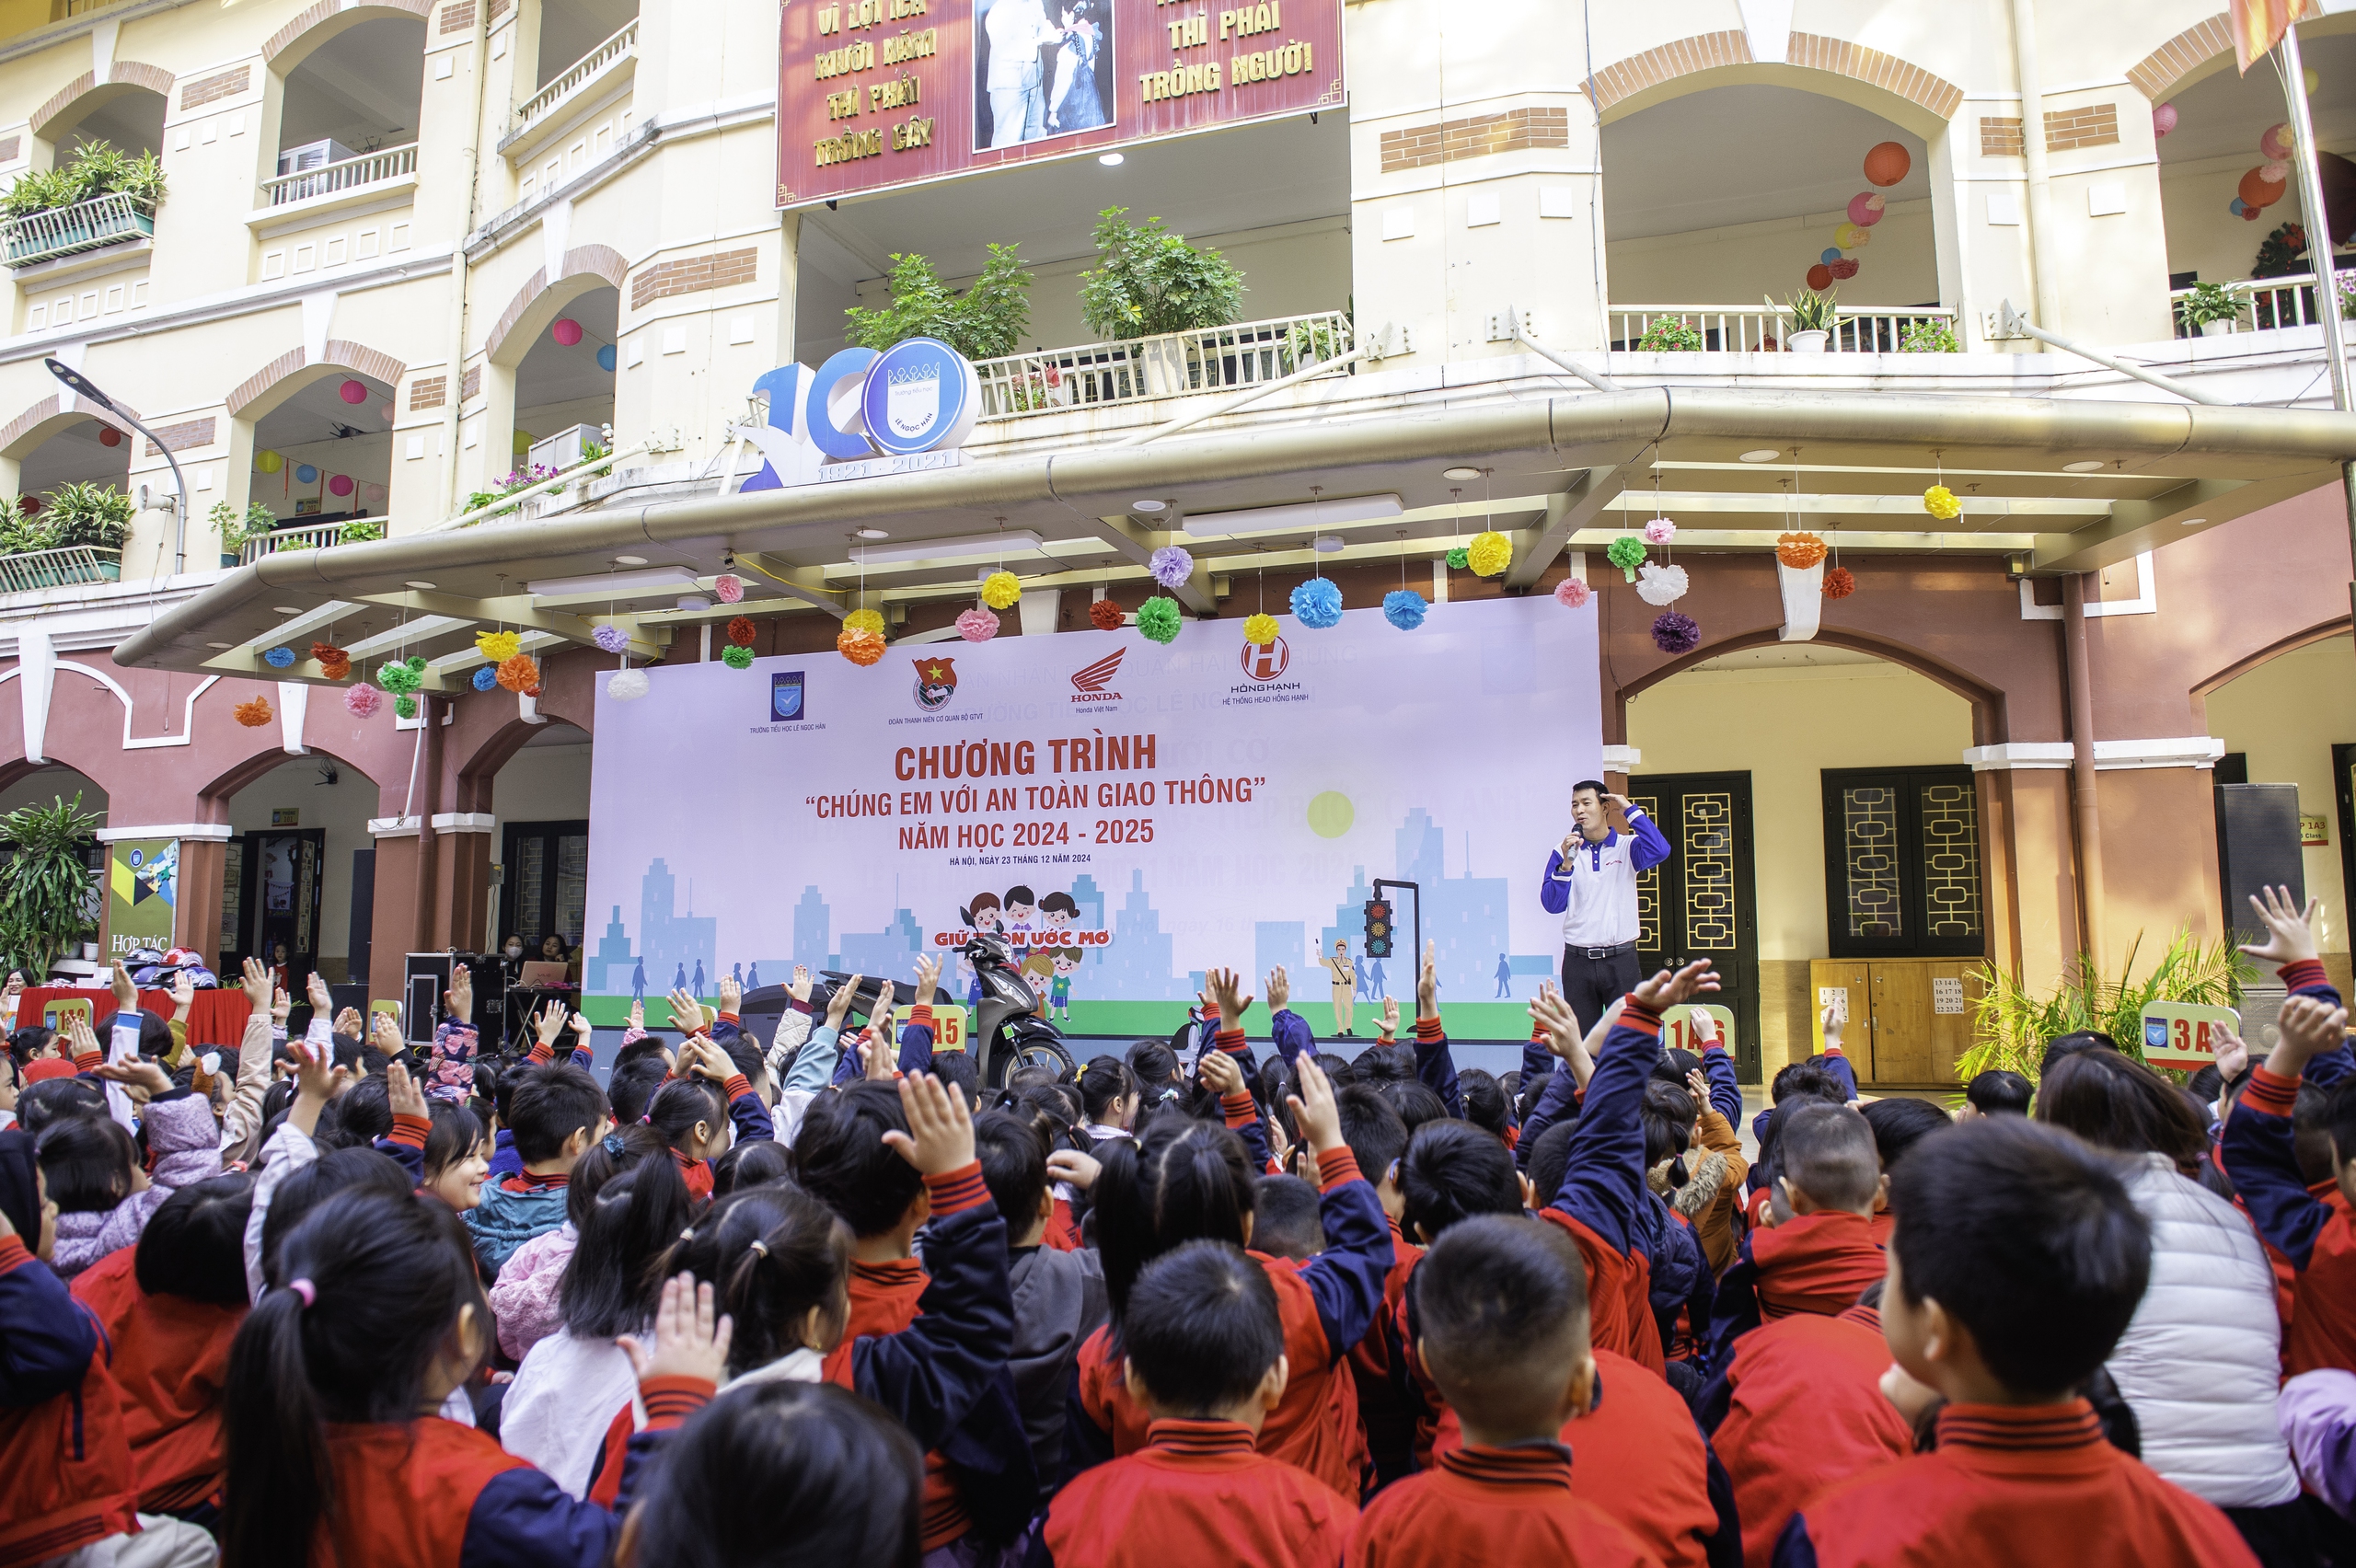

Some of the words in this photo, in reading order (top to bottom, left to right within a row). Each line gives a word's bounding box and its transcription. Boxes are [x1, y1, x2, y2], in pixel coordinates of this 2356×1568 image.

[818, 2, 839, 35] VÌ
[1168, 10, 1207, 50] THÌ
[1219, 0, 1280, 40] PHẢI
[814, 38, 874, 81] MƯỜI
[883, 28, 937, 66] NĂM
[1139, 58, 1222, 103] TRỒNG
[1231, 39, 1312, 87] NGƯỜI
[826, 84, 860, 121] THÌ
[868, 71, 920, 112] PHẢI
[814, 124, 884, 167] TRỒNG
[891, 114, 935, 153] CÂY
[818, 461, 872, 482] 1921
[892, 451, 953, 473] 2021
[1070, 692, 1123, 703] HONDA
[1222, 697, 1230, 706] HỆ
[1232, 696, 1253, 705] THỐNG
[1254, 696, 1271, 704] HEAD
[1272, 694, 1290, 702] HỒNG
[1290, 694, 1309, 702] HẠNH
[750, 725, 770, 733] TRƯỜNG
[770, 724, 781, 732] TIỂU
[781, 724, 792, 732] HỌC
[801, 723, 814, 732] NGỌC
[814, 722, 826, 731] HÂN
[888, 717, 904, 725] ĐOÀN
[905, 716, 922, 724] THANH
[922, 715, 935, 723] NIÊN
[944, 714, 960, 722] QUAN
[961, 713, 969, 721] BỘ
[969, 712, 984, 721] GTVT
[895, 738, 1035, 781] CHƯƠNG
[1047, 728, 1156, 774] TRÌNH
[900, 790, 932, 815] EM
[940, 783, 977, 813] VỚI
[985, 788, 1017, 813] AN
[1025, 779, 1088, 811] TOÀN
[1097, 781, 1156, 808] GIAO
[899, 821, 949, 850] NĂM
[957, 823, 1005, 853] HỌC
[1012, 821, 1069, 847] 2024
[1095, 818, 1154, 845] 2025
[950, 856, 960, 866] HÀ
[962, 855, 977, 867] NỘI,
[979, 854, 999, 865] NGÀY
[1001, 856, 1011, 864] 23
[1013, 854, 1038, 864] THÁNG
[1041, 855, 1050, 863] 12
[1052, 853, 1069, 863] NĂM
[1072, 854, 1091, 863] 2024
[111, 934, 141, 953] HỢP
[143, 934, 167, 951] TÁC
[934, 929, 969, 946] GIỮ
[1031, 928, 1072, 945] ƯỚC
[1078, 930, 1110, 945] MƠ
[932, 1018, 959, 1044] A5
[2174, 1019, 2213, 1054] 3A
